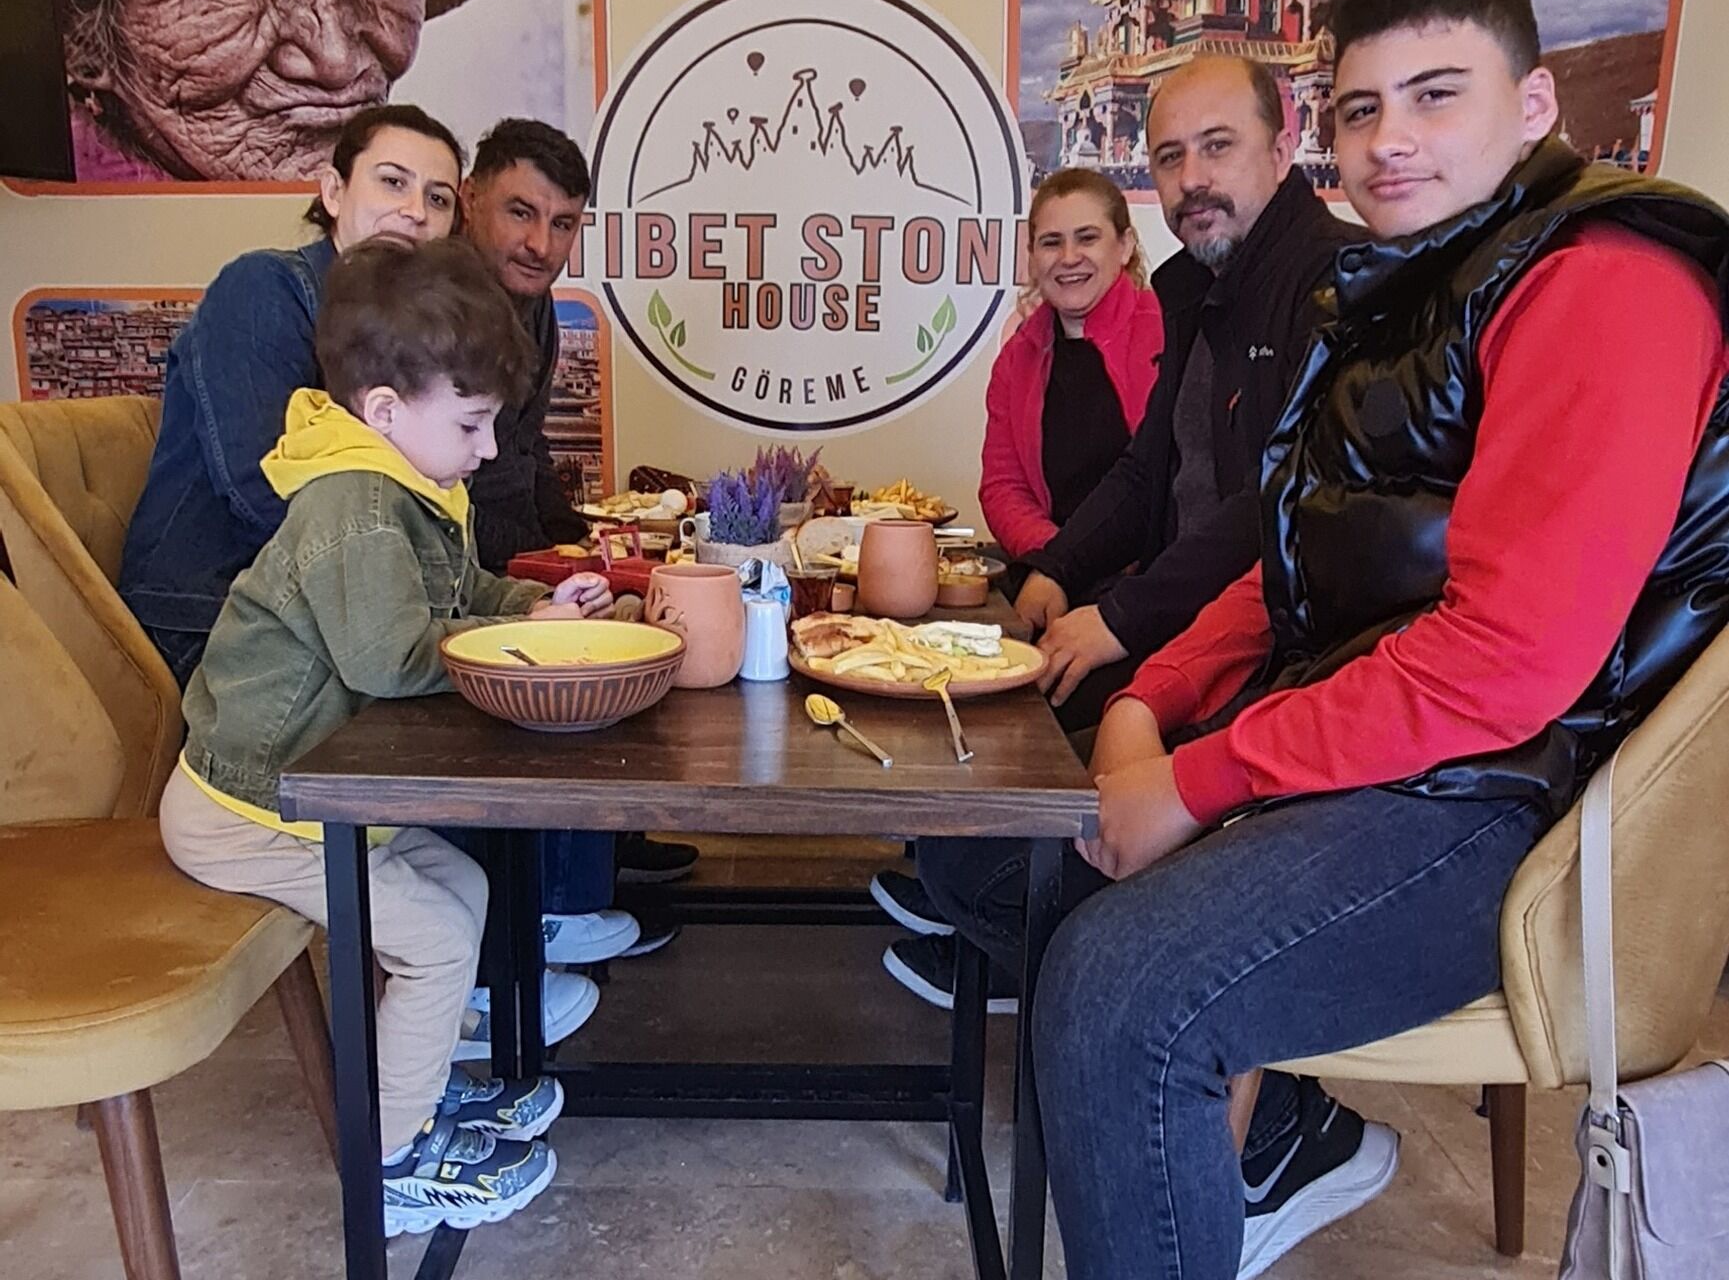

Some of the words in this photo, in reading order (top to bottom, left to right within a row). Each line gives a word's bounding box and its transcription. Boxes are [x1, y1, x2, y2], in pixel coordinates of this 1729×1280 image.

[567, 212, 777, 281] TIBET
[723, 282, 881, 332] HOUSE
[731, 366, 870, 404] GÖREME
